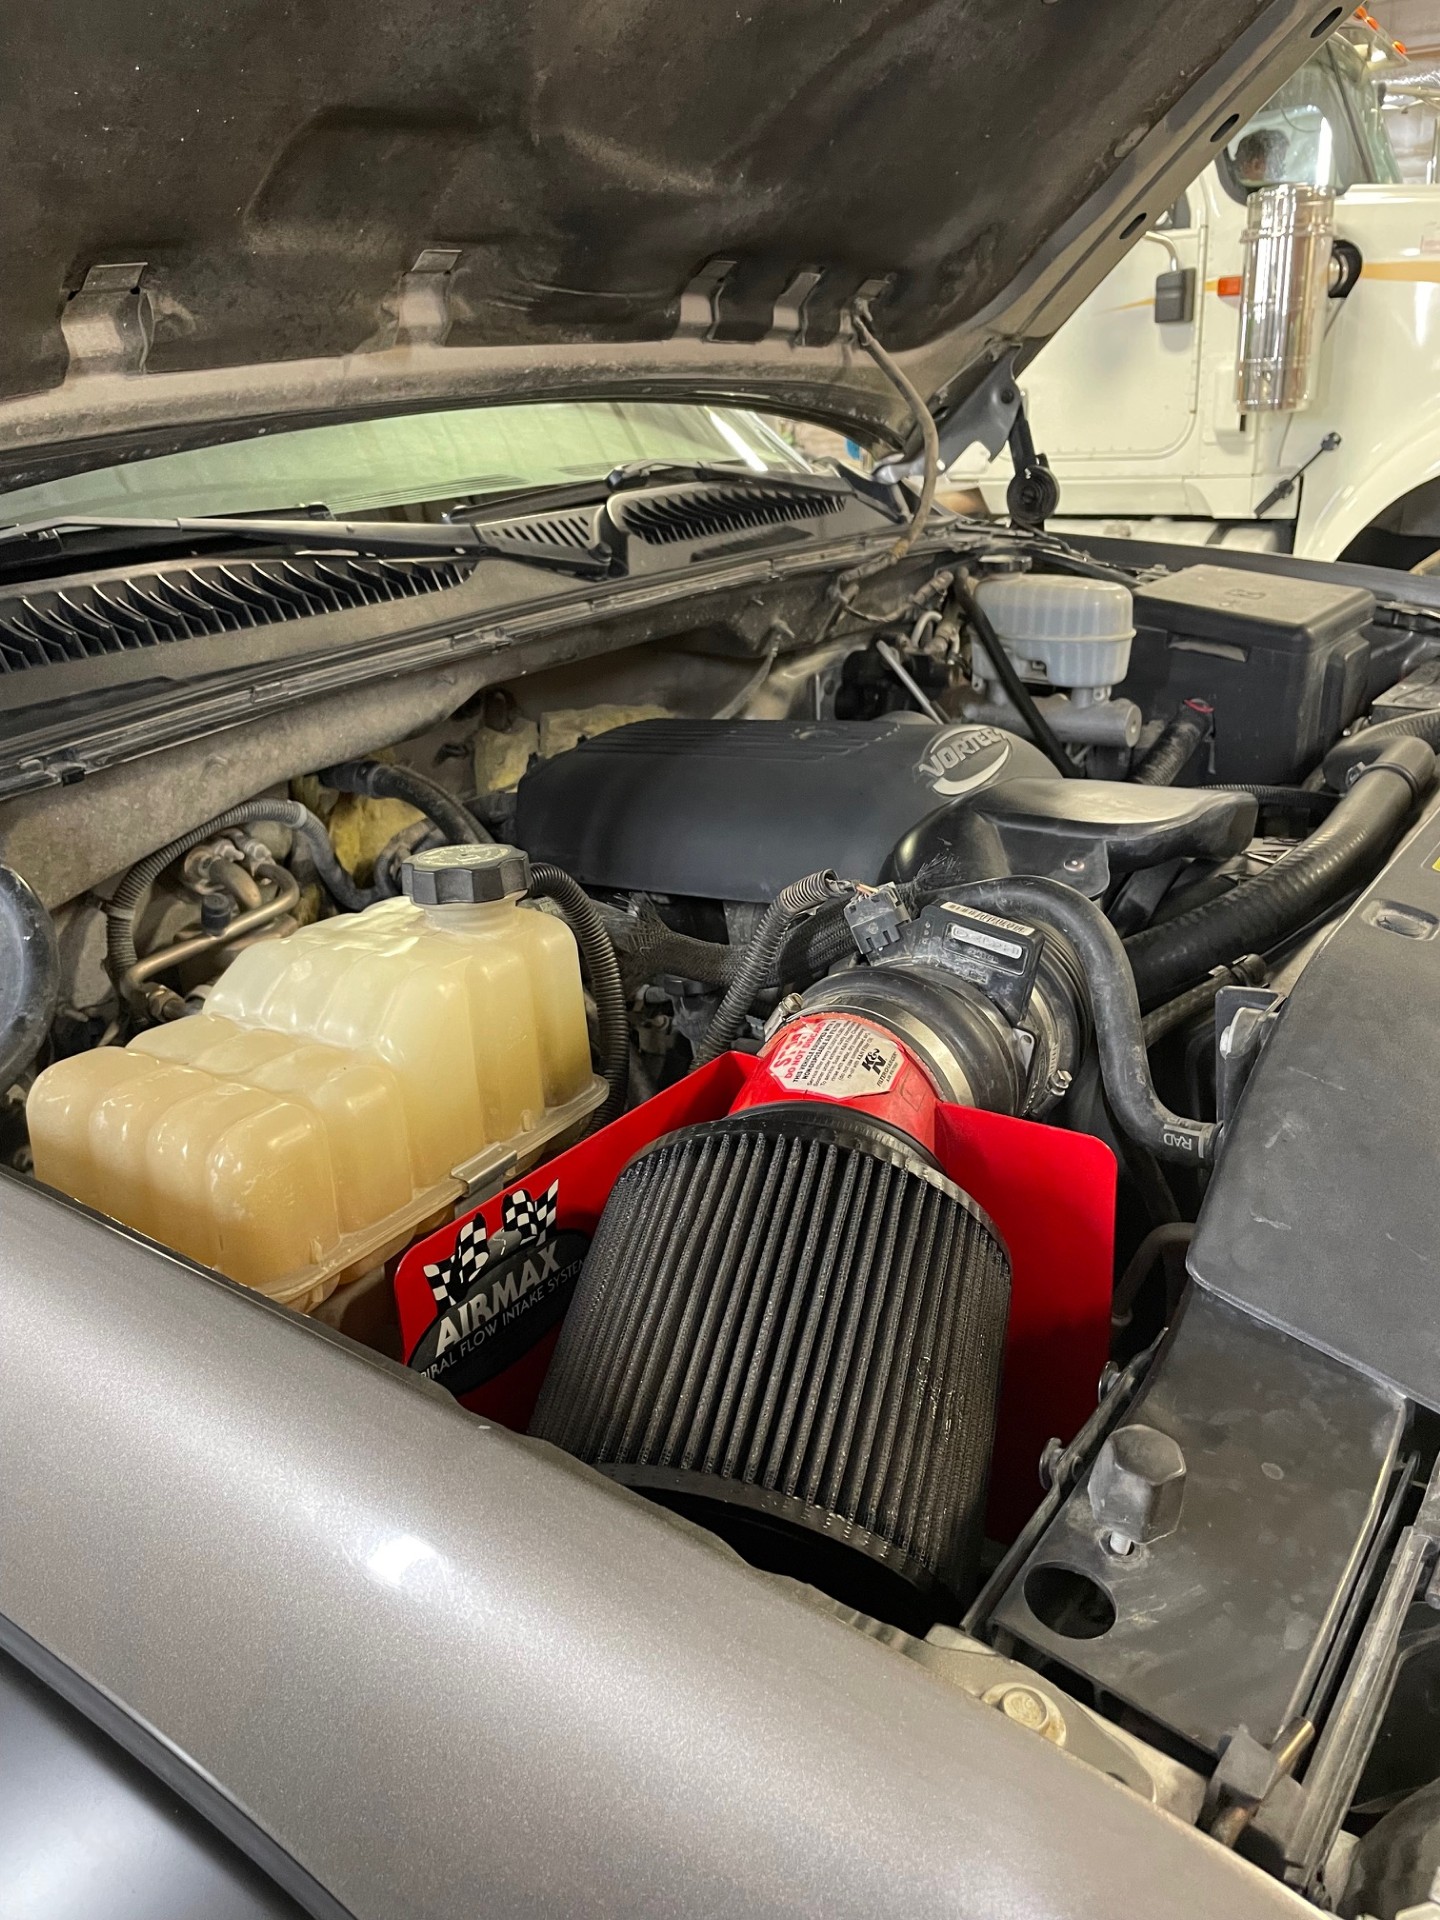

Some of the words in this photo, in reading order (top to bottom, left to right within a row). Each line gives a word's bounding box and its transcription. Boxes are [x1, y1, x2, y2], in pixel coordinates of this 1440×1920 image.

[919, 727, 1003, 777] VORTEC
[784, 1068, 795, 1078] DO
[791, 1050, 806, 1065] NOT
[1163, 1133, 1192, 1151] RAD
[435, 1239, 560, 1358] AIRMAX
[460, 1319, 498, 1357] FLOW
[503, 1286, 545, 1327] INTAKE
